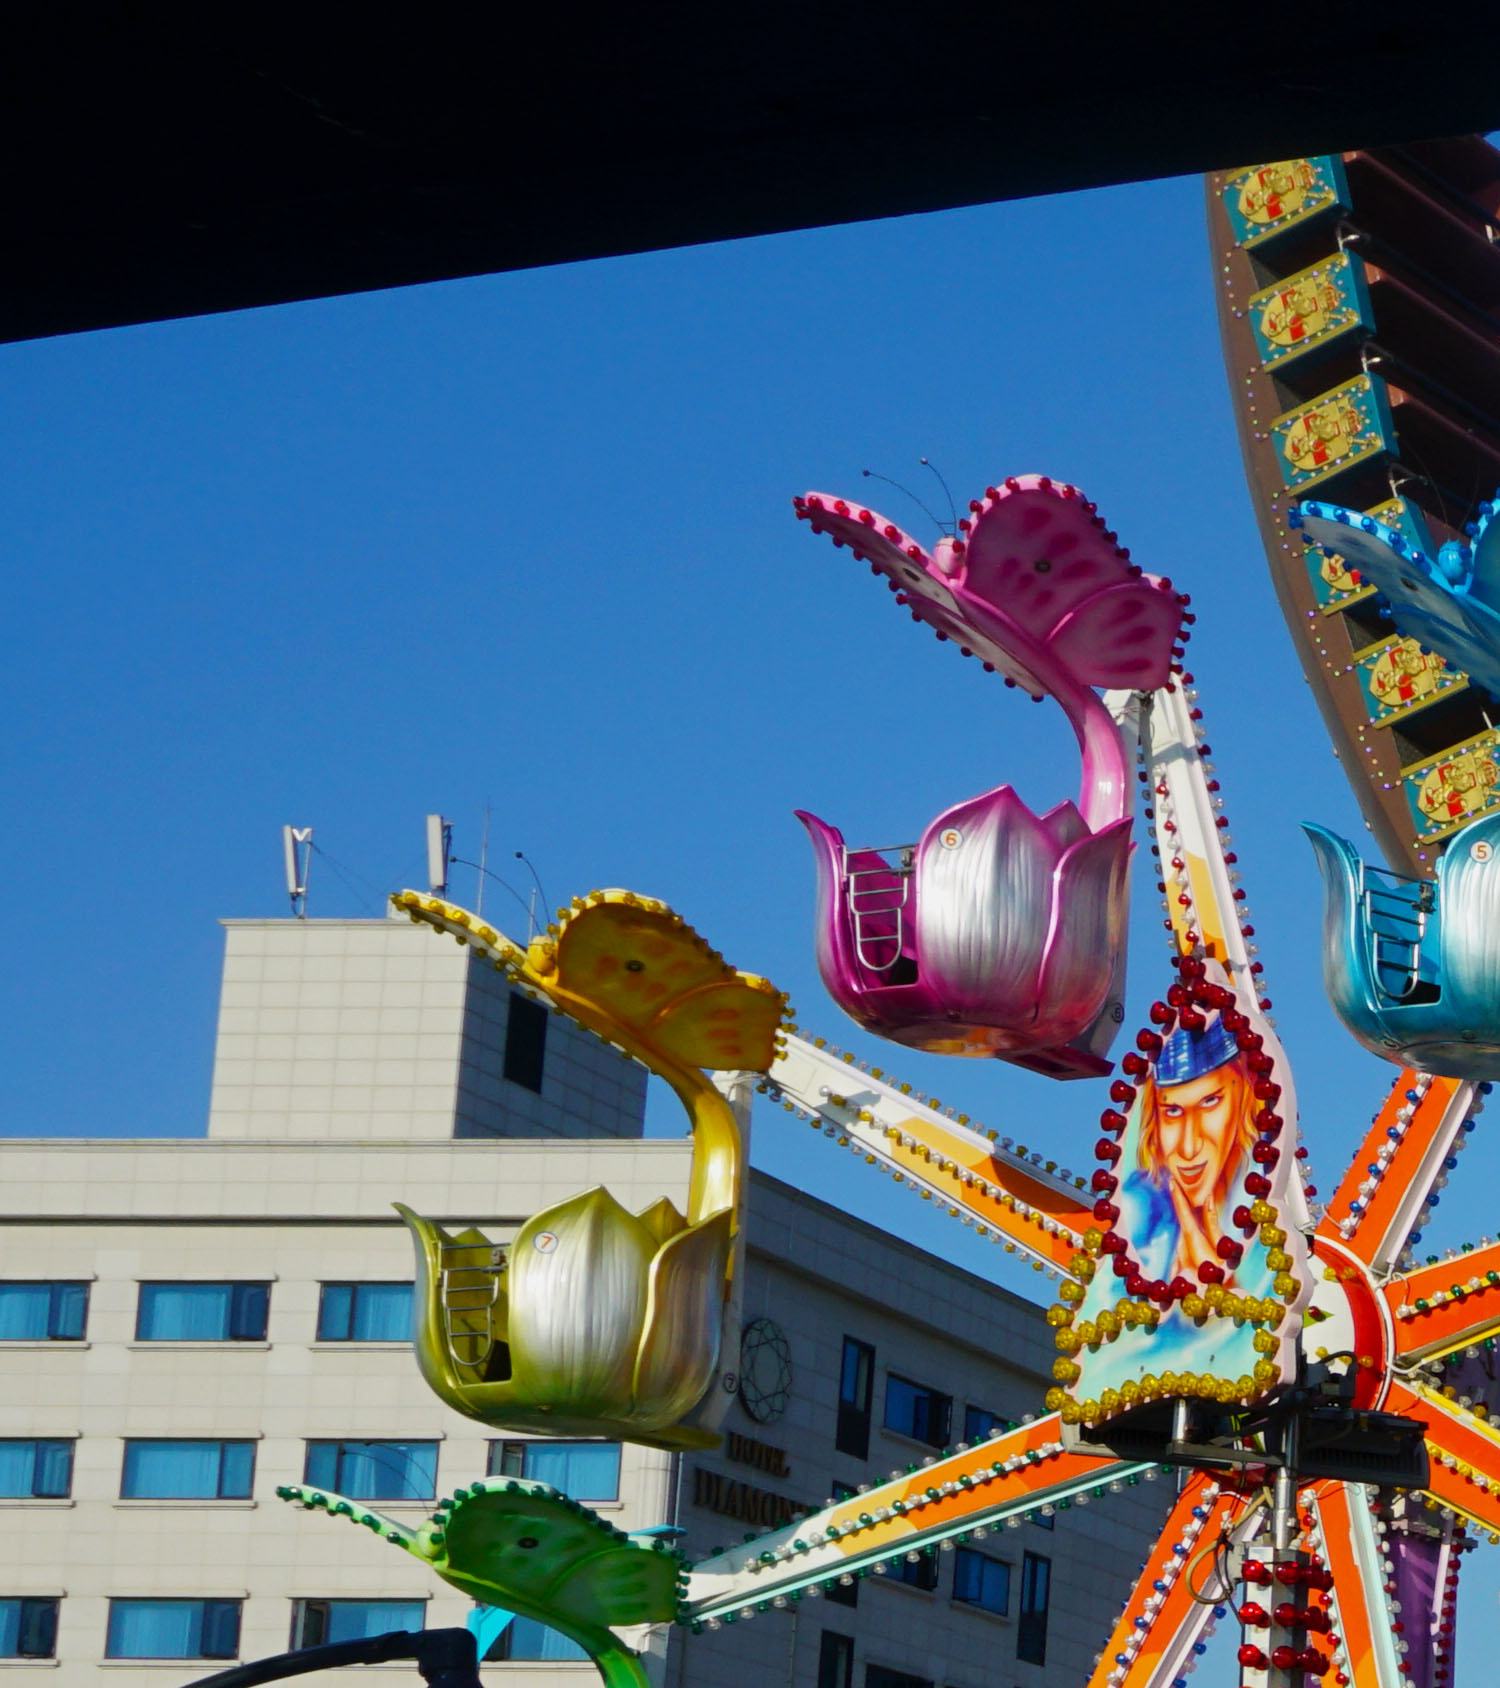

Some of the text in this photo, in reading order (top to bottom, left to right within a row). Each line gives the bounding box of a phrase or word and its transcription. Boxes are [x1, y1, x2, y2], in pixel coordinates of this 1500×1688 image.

[945, 832, 957, 847] 6
[1476, 843, 1488, 859] 5
[539, 1234, 552, 1249] 7
